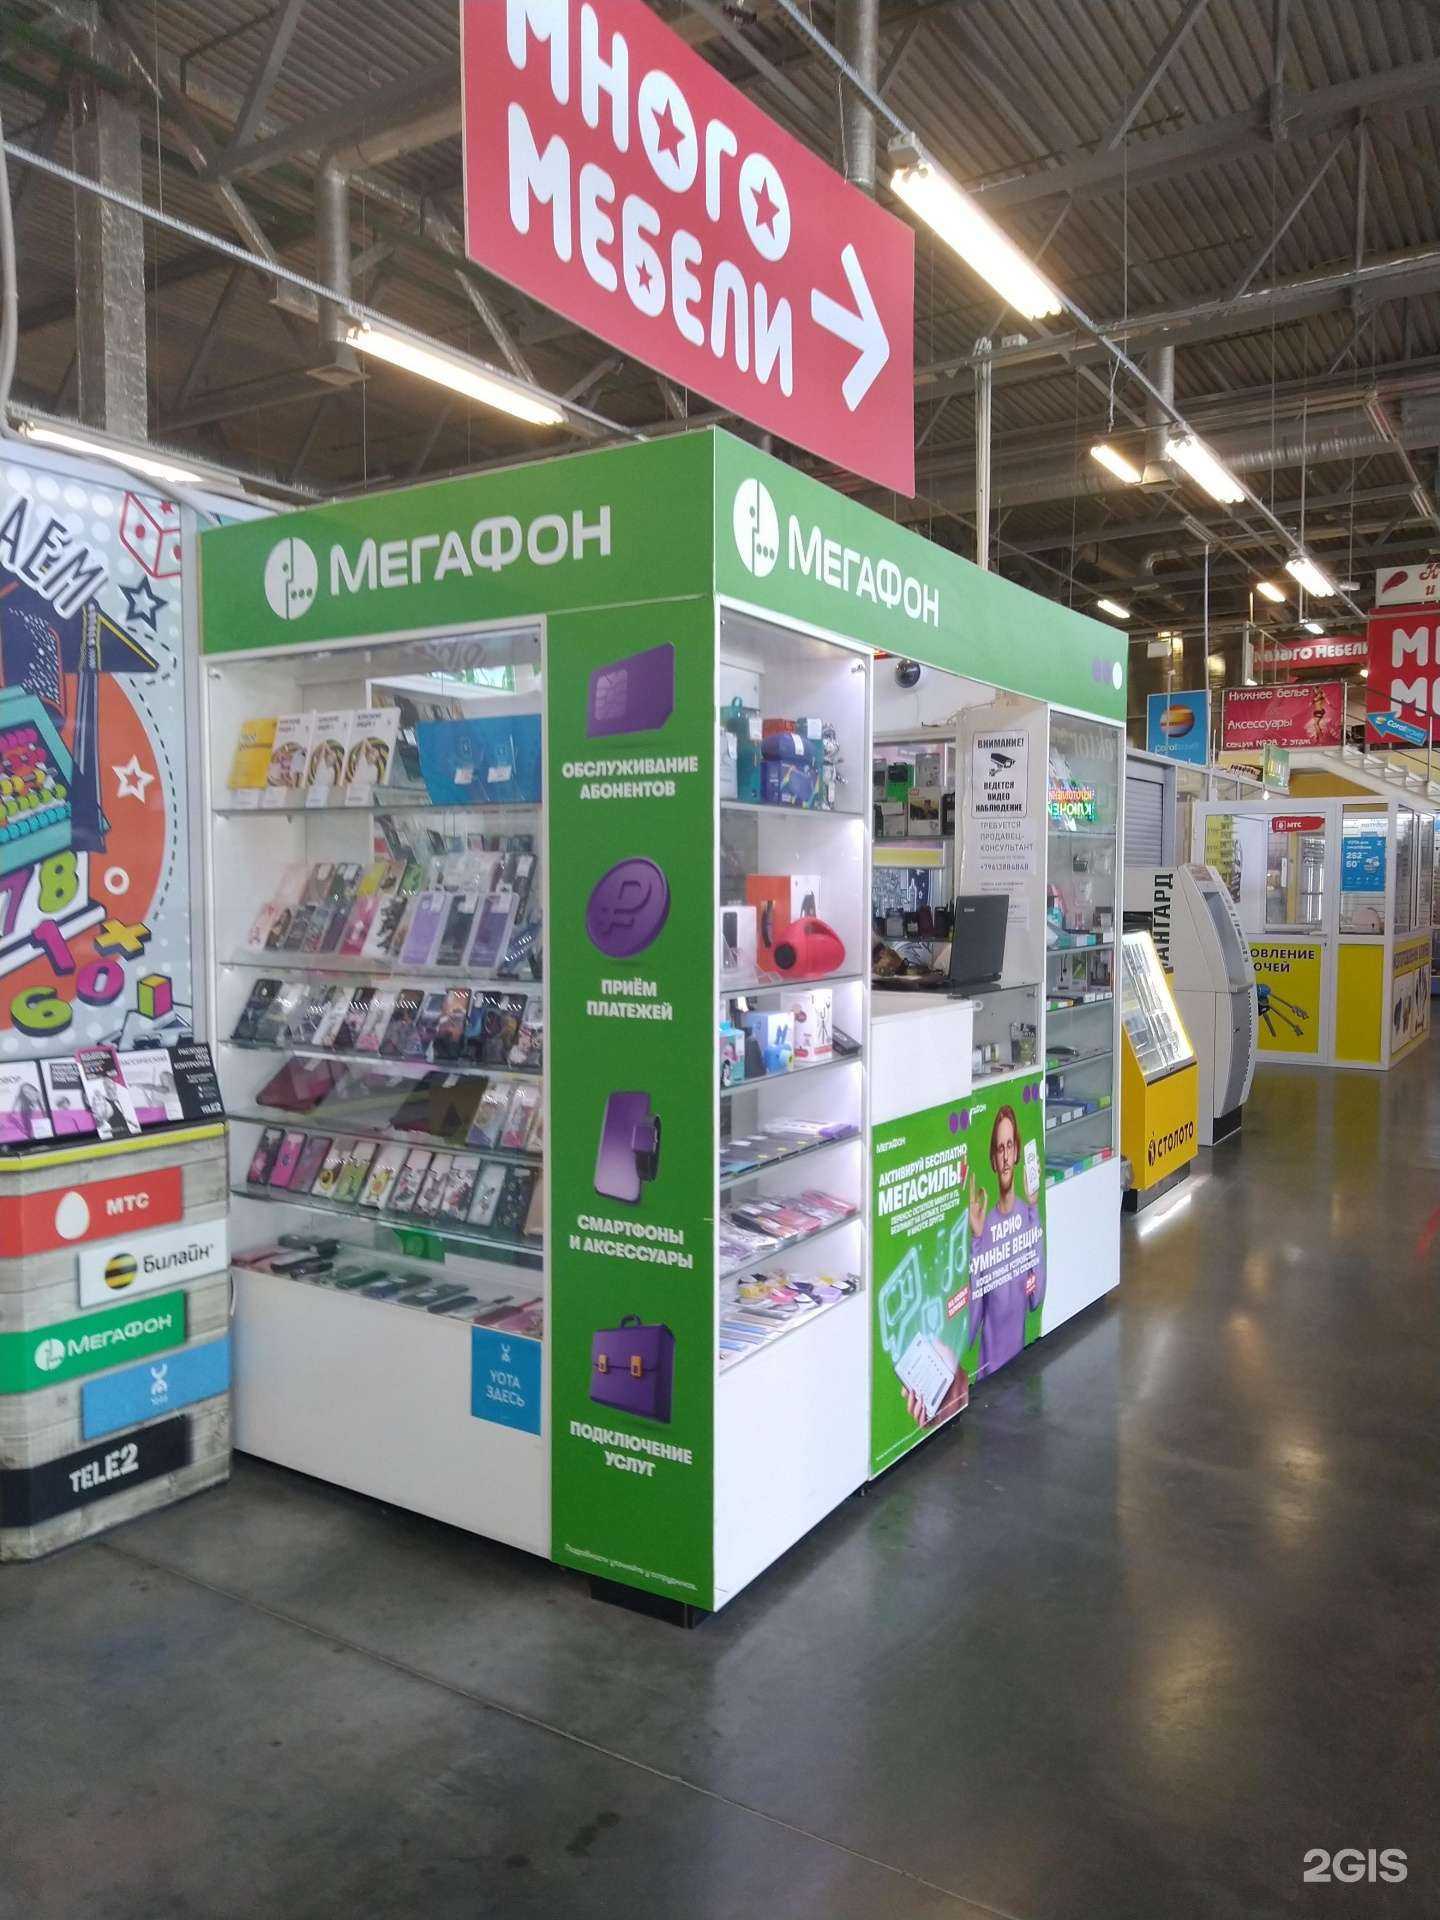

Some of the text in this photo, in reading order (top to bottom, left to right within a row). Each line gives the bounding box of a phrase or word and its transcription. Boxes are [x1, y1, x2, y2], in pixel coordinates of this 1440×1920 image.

[507, 0, 791, 262] МНОГО
[508, 102, 793, 398] МЕБЕЛИ
[330, 505, 611, 596] МЕГАФОН
[787, 515, 940, 629] МЕГАФОН
[1229, 688, 1310, 701] Нижнее белье
[1227, 719, 1293, 731] Аксессуары
[977, 738, 1024, 749] ВНИМАНИЕ!
[562, 756, 698, 778] ОБСЛУЖИВАНИЕ
[580, 781, 676, 799] АБОНЕНТОВ
[983, 781, 1014, 790] ВЕДЕТСЯ
[987, 793, 1010, 801] ВИДЕО
[975, 804, 1022, 812] НАБЛЮДЕНИЕ
[980, 821, 1021, 830] ТРЕБУЕТСЯ
[601, 977, 657, 997] ПРИЁМ
[586, 1000, 673, 1020] ПЛАТЕЖЕЙ
[1157, 1119, 1194, 1156] СТОЛОТО
[879, 1143, 967, 1187] АКТИВИРУЙ БЕСПЛАТНО
[879, 1161, 961, 1216] МЕГАСИЛЫ
[106, 1192, 150, 1216] МТС
[577, 1213, 684, 1245] СМАРТФОНЫ
[990, 1213, 1022, 1242] ТАРИФ
[143, 1243, 212, 1277] Билайн
[569, 1236, 694, 1270] И АКСЕССУАРЫ
[67, 1314, 173, 1358] МЕГАФОН
[489, 1369, 522, 1390] YOTA
[486, 1386, 527, 1409] ЗДЕСЬ
[570, 1420, 693, 1465] ПОДКЛЮЧЕНИЕ
[70, 1442, 139, 1493] TELE2
[605, 1450, 656, 1478] УСЛУГ
